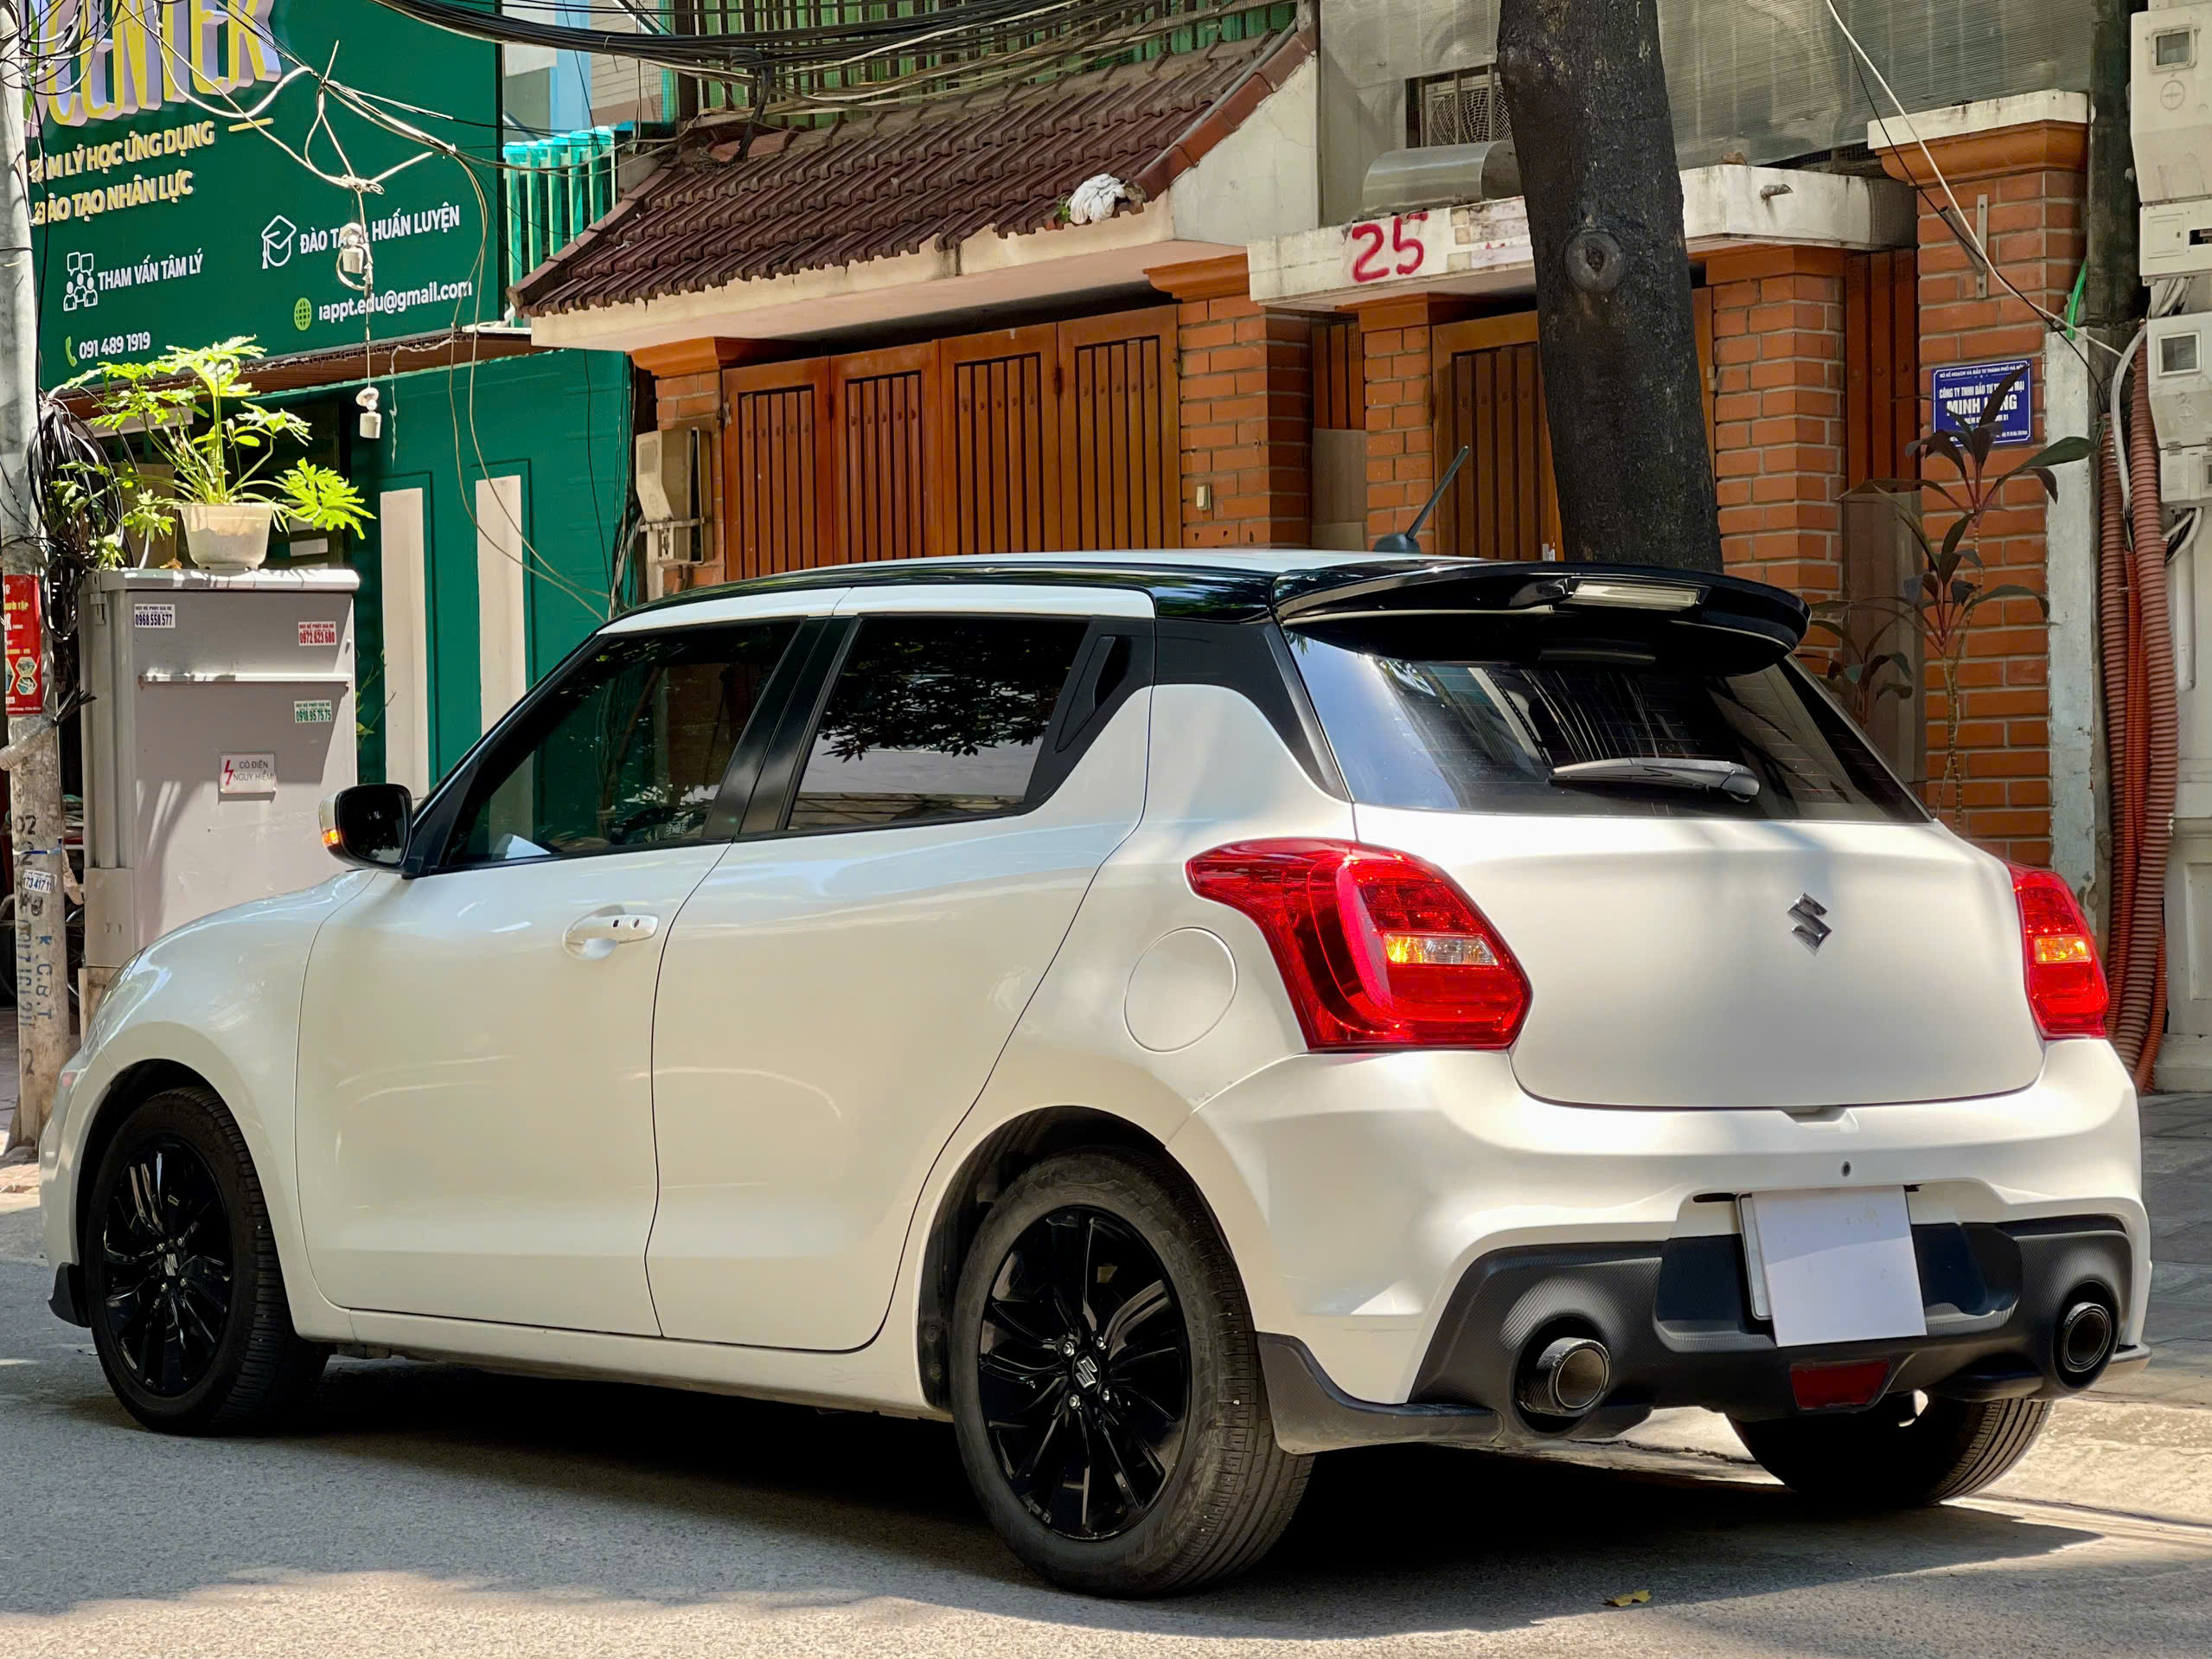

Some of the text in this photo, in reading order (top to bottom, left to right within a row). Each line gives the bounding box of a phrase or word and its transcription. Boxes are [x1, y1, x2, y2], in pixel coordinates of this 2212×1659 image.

[65, 144, 86, 176] LÝ
[86, 141, 124, 174] HỌC
[124, 131, 163, 163] ỨNG
[163, 120, 215, 157] DỤNG
[72, 189, 106, 222] TẠO
[106, 174, 157, 211] NHÂN
[158, 169, 194, 203] LỰC
[299, 227, 328, 254] ĐÀO
[372, 208, 411, 242] HUẤN
[413, 201, 460, 234] LUYỆN
[1352, 211, 1429, 283] 25
[97, 247, 203, 291] THAM VẤN TÂM LÝ
[79, 331, 151, 360] 091 489 1919
[1939, 387, 1953, 399] CÔNG
[1953, 387, 1960, 397] TY
[1947, 398, 1980, 416] MINH
[233, 772, 253, 781] NGUY
